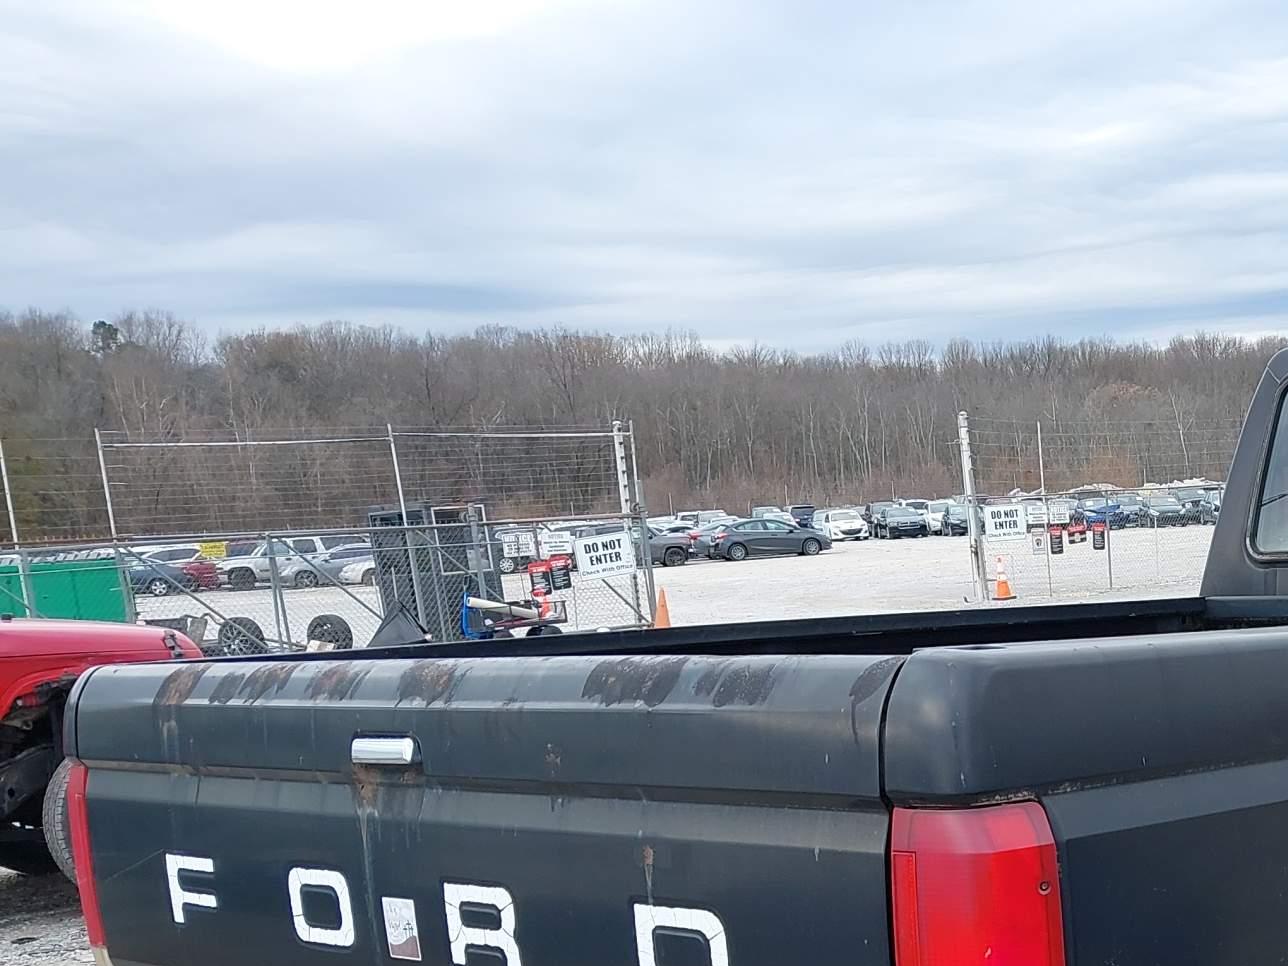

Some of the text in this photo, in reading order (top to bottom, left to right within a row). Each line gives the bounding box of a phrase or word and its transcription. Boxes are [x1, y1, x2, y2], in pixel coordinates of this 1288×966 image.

[991, 510, 1002, 520] DO
[1003, 509, 1018, 519] NOT
[994, 519, 1018, 530] ENTER
[584, 542, 599, 554] DO
[601, 538, 622, 551] NOT
[589, 551, 622, 566] ENTER
